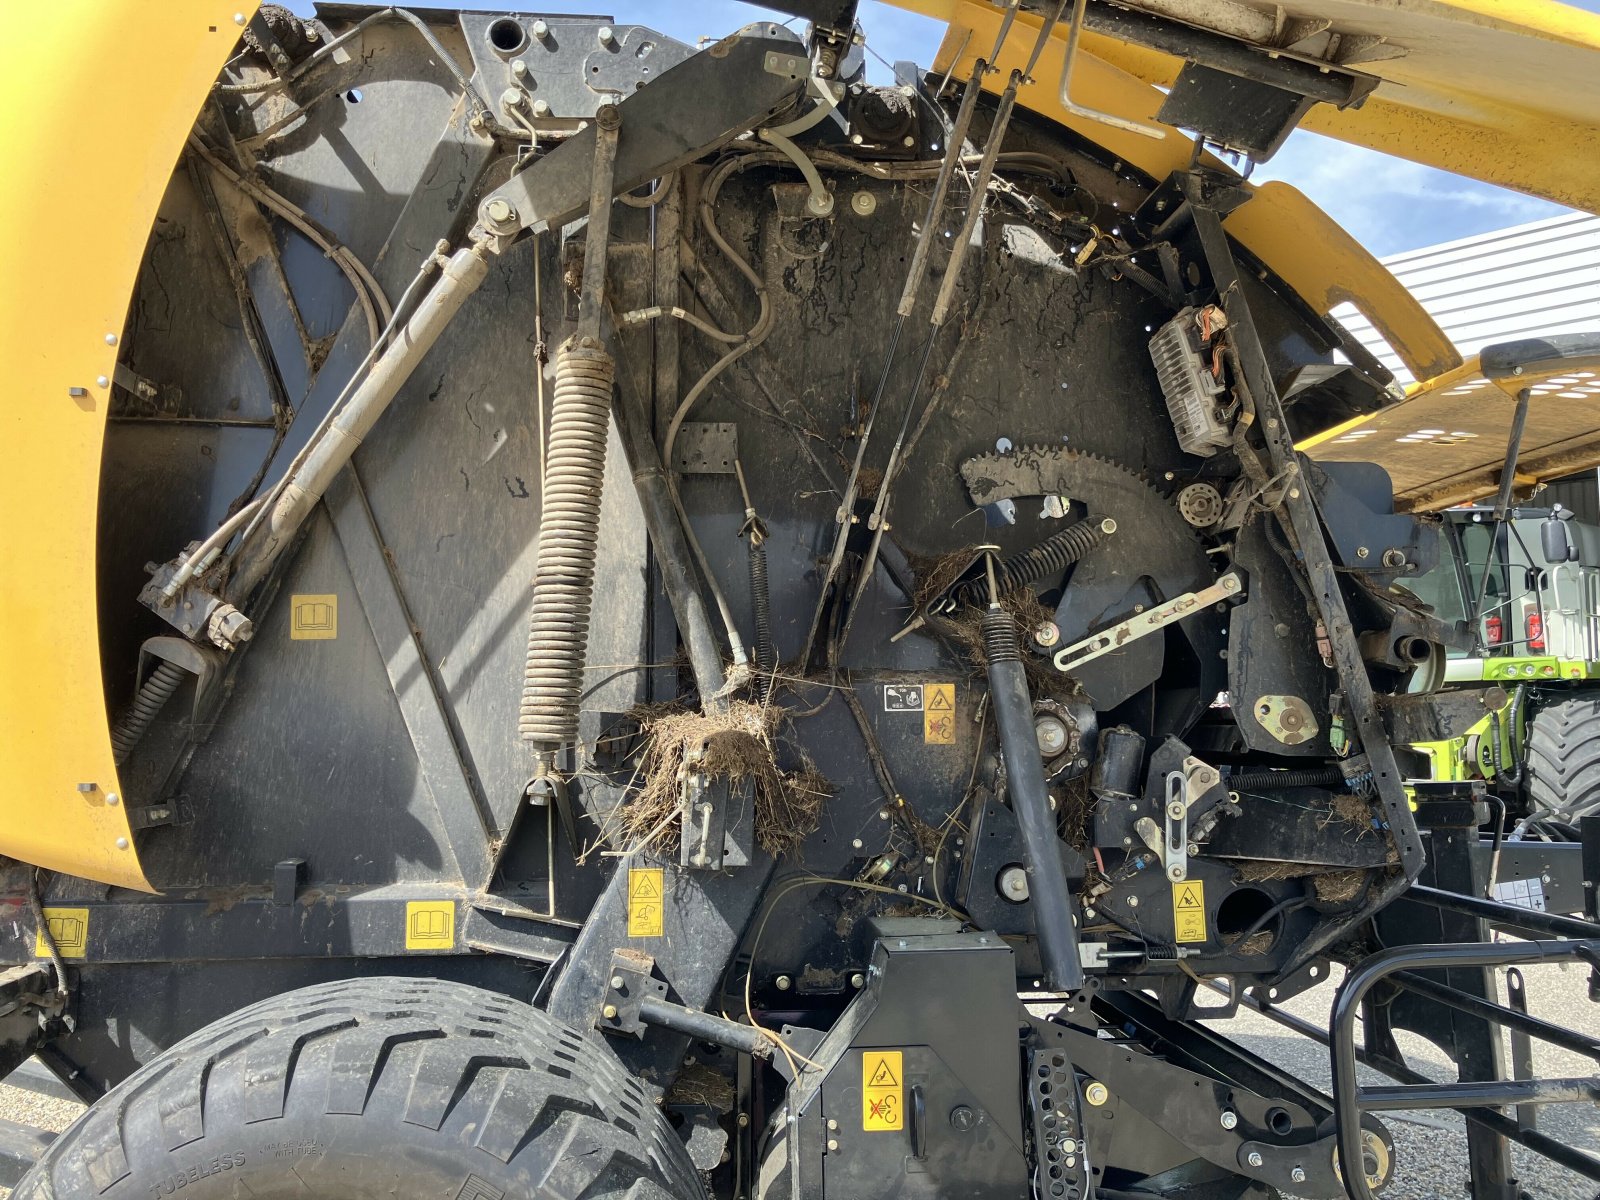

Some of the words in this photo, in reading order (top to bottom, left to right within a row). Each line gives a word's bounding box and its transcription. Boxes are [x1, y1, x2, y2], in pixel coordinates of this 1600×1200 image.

[275, 1149, 294, 1158] WITH
[297, 1146, 317, 1155] TUBE
[149, 1149, 246, 1200] TUBELESS
